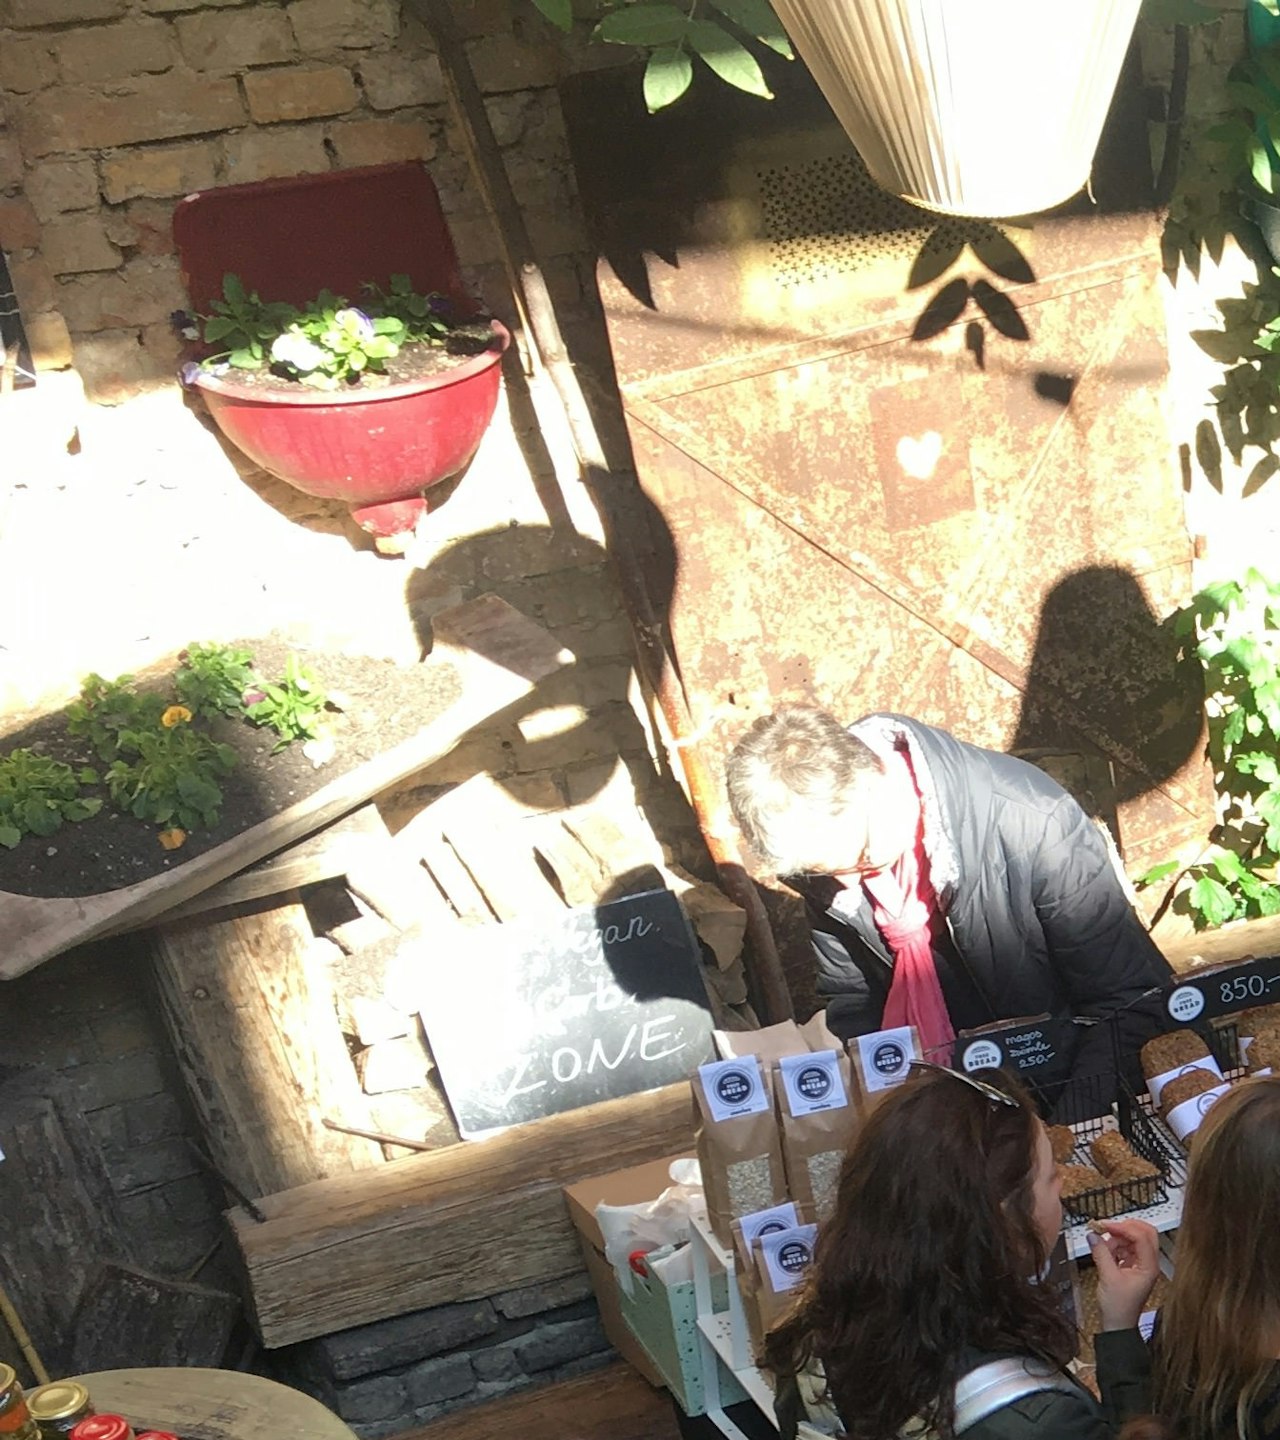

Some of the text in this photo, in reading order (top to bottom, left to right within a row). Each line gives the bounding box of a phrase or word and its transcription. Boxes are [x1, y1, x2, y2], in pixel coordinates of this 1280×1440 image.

[1173, 1000, 1201, 1014] BREAD
[1005, 1030, 1043, 1047] magos
[500, 1014, 688, 1107] ZONE
[968, 1056, 998, 1068] BREAD
[1019, 1052, 1056, 1069] 250.-
